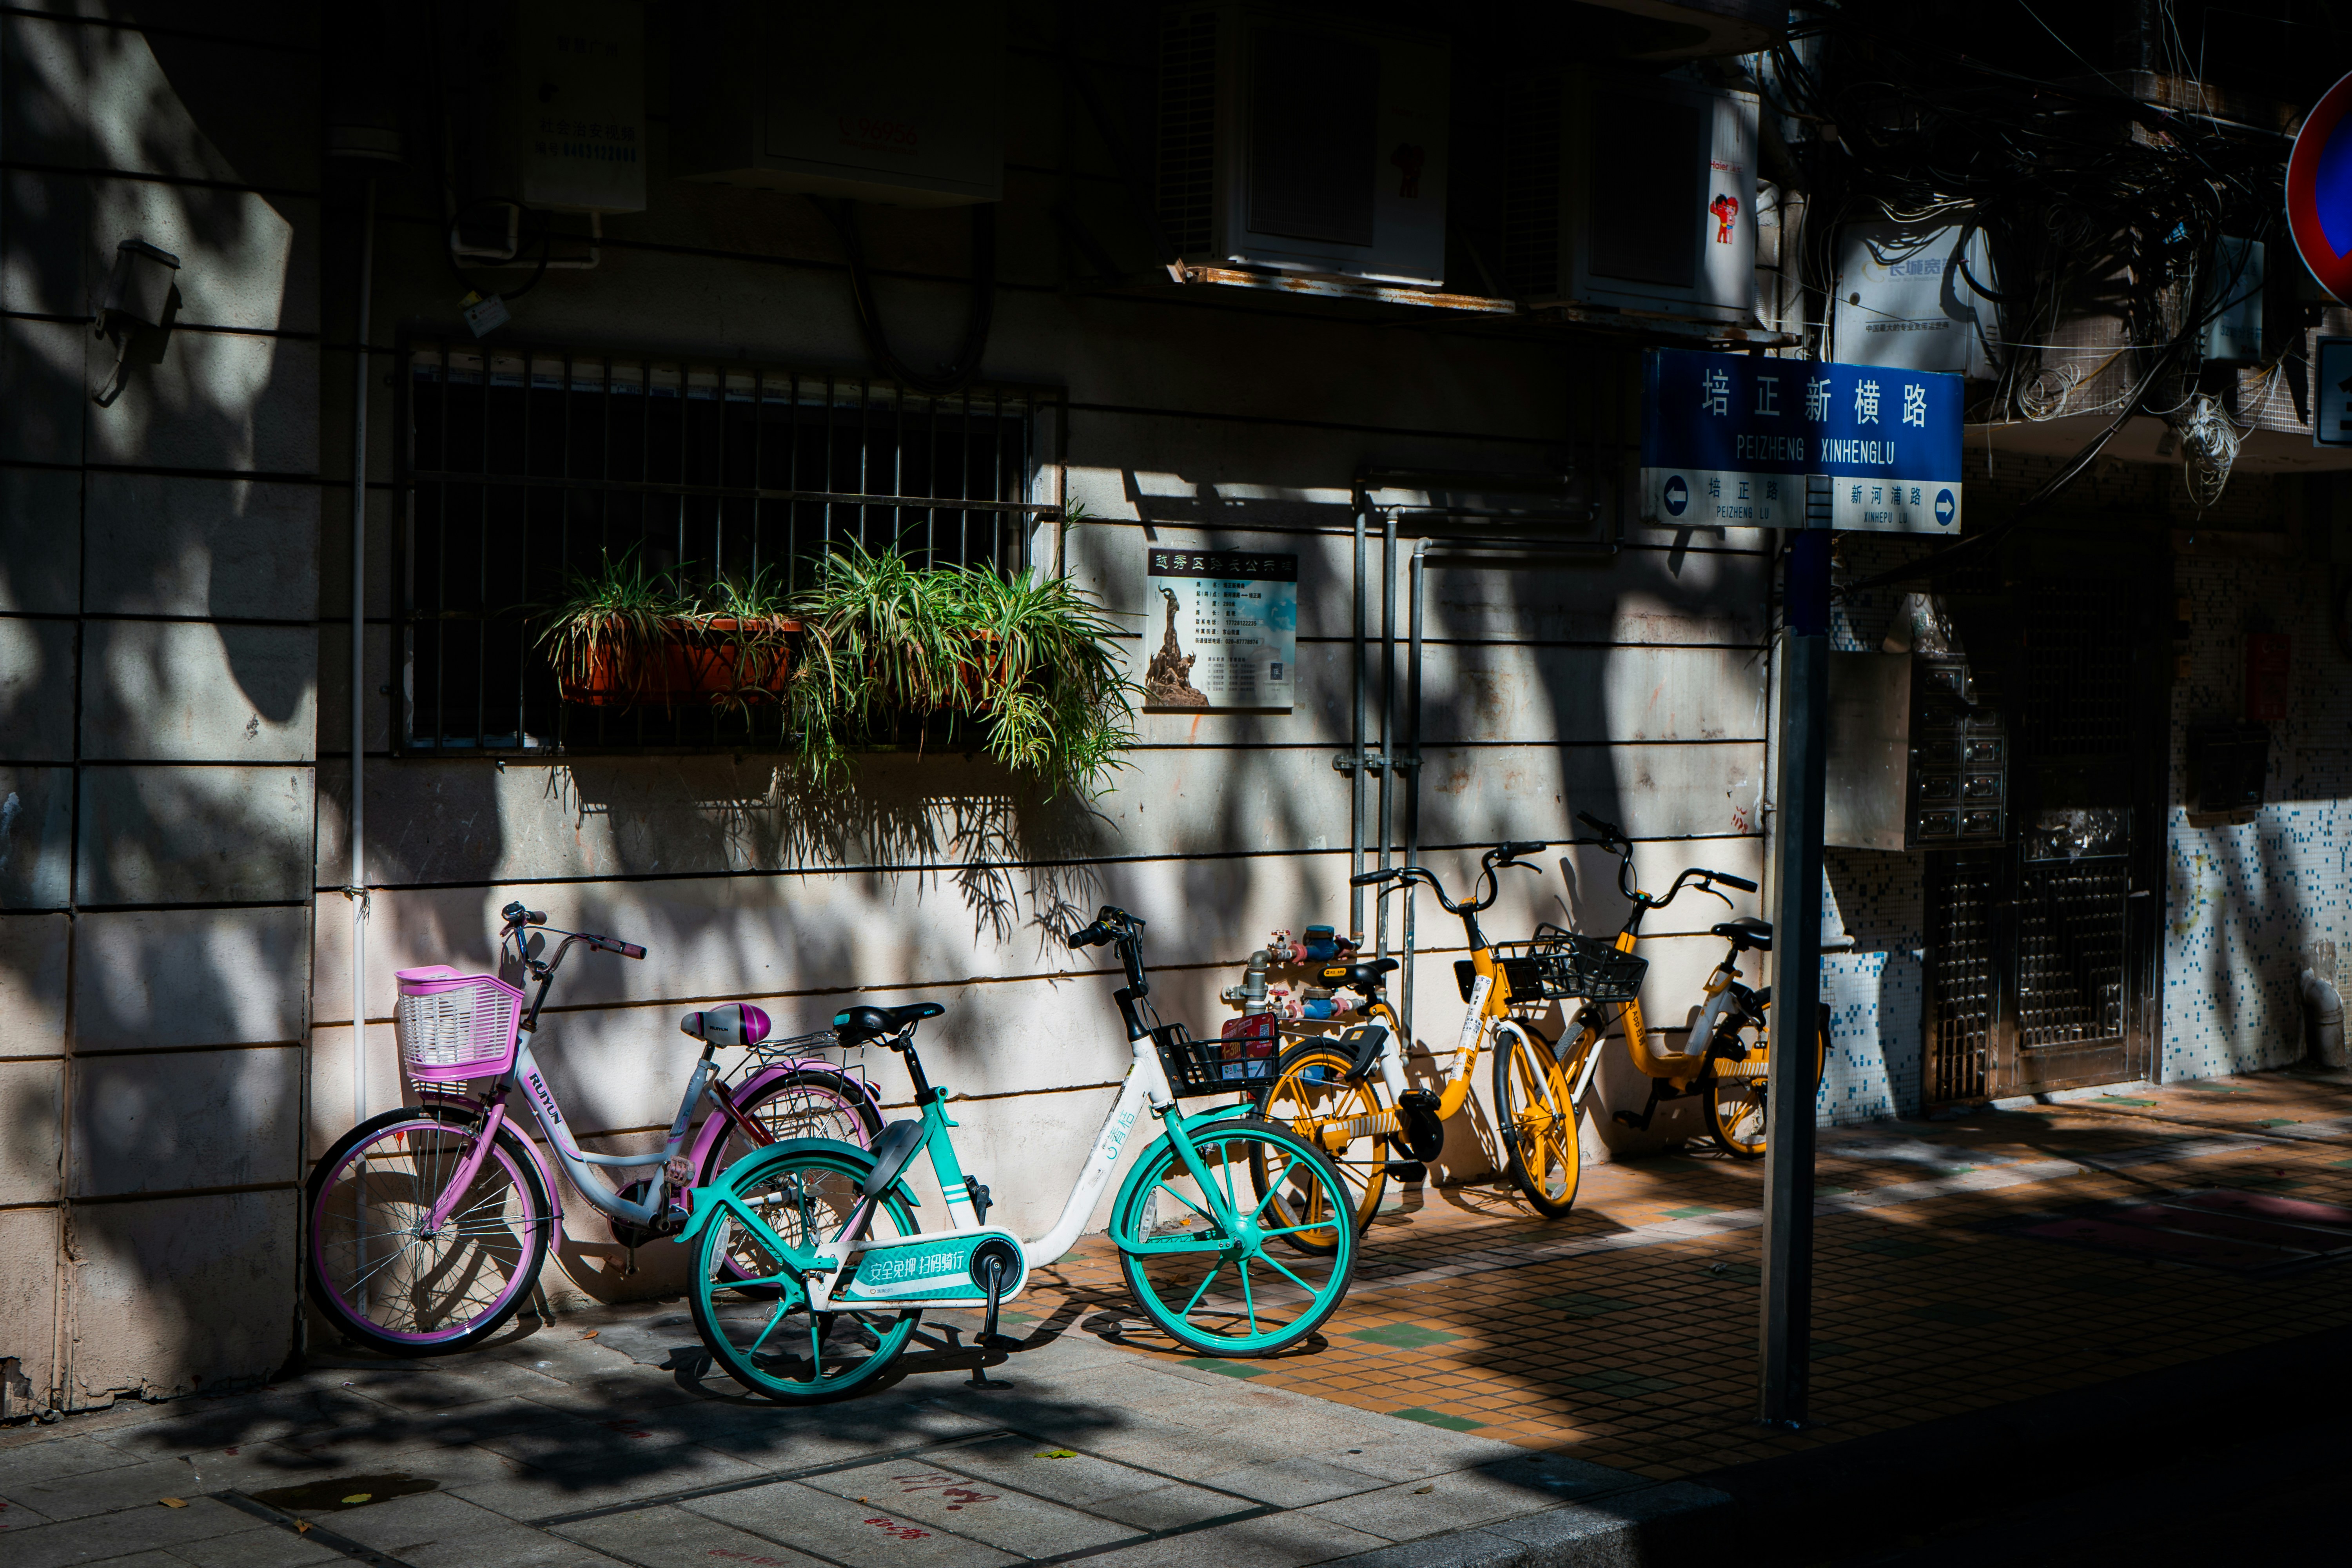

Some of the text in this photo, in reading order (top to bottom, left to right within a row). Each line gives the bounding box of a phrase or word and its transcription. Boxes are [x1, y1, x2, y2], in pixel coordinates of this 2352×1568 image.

[556, 35, 618, 57] 智慧广州
[539, 117, 635, 142] 社会治安视频
[858, 117, 918, 145] 96956
[1710, 160, 1729, 171] Haier
[1702, 368, 1927, 428] 培正新横路
[1737, 434, 1895, 465] PEIZHENG XINHENGLU
[1708, 477, 1778, 501] 培正路
[1851, 485, 1922, 506] 新河浦路
[1717, 505, 1769, 519] PEIZHENG LU
[1864, 511, 1907, 524] XINHEPU LU
[529, 1073, 562, 1125] RUIYUN
[870, 1258, 916, 1281] 安全免押
[919, 1251, 964, 1274] 扫码骑行
